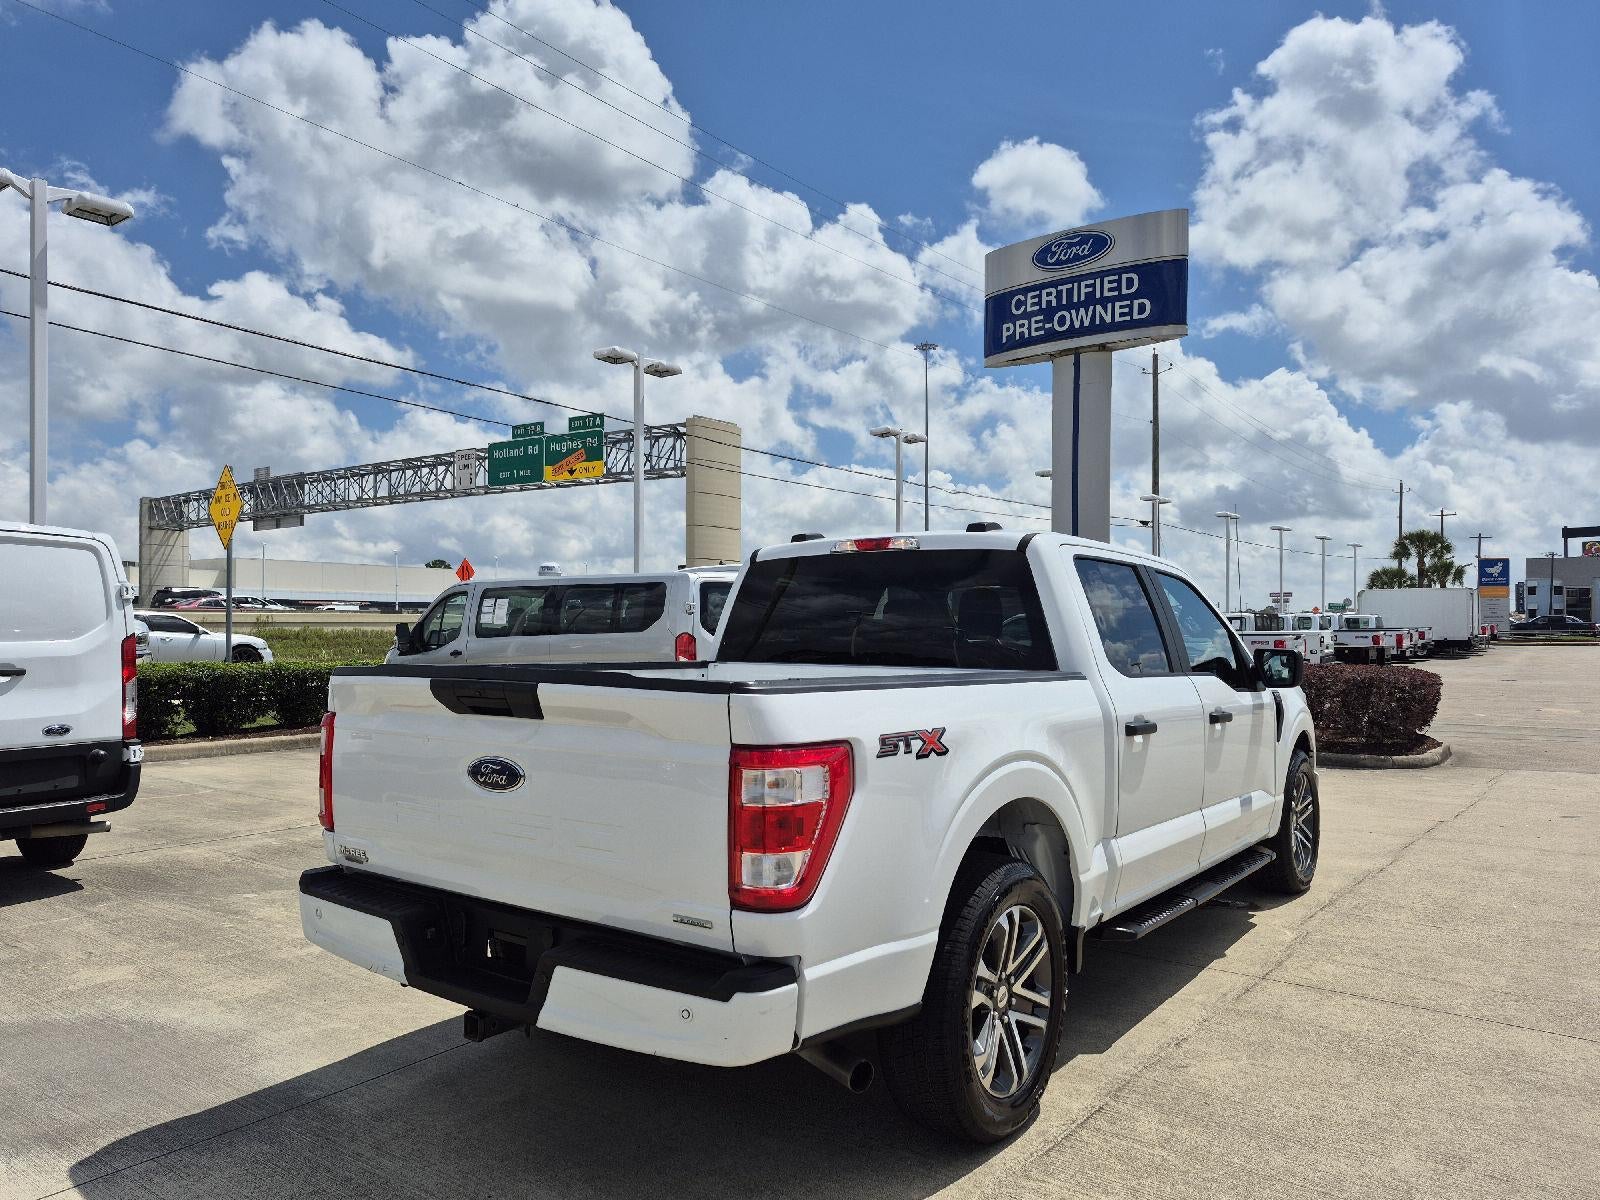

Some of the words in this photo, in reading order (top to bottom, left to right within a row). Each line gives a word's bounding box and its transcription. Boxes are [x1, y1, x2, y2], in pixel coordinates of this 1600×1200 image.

[1047, 236, 1094, 264] Ford
[1011, 272, 1139, 315] CERTIFIED
[1002, 298, 1151, 344] PRE-OWNED
[571, 420, 583, 428] EXIT
[586, 417, 594, 427] 17
[595, 416, 601, 426] A
[493, 446, 524, 459] Holland
[528, 444, 539, 455] Rd
[550, 439, 583, 452] Hughes
[586, 436, 599, 447] Rd
[457, 453, 475, 461] SPEED
[579, 466, 596, 474] ONLY
[876, 727, 949, 760] STX
[477, 763, 509, 785] Ford
